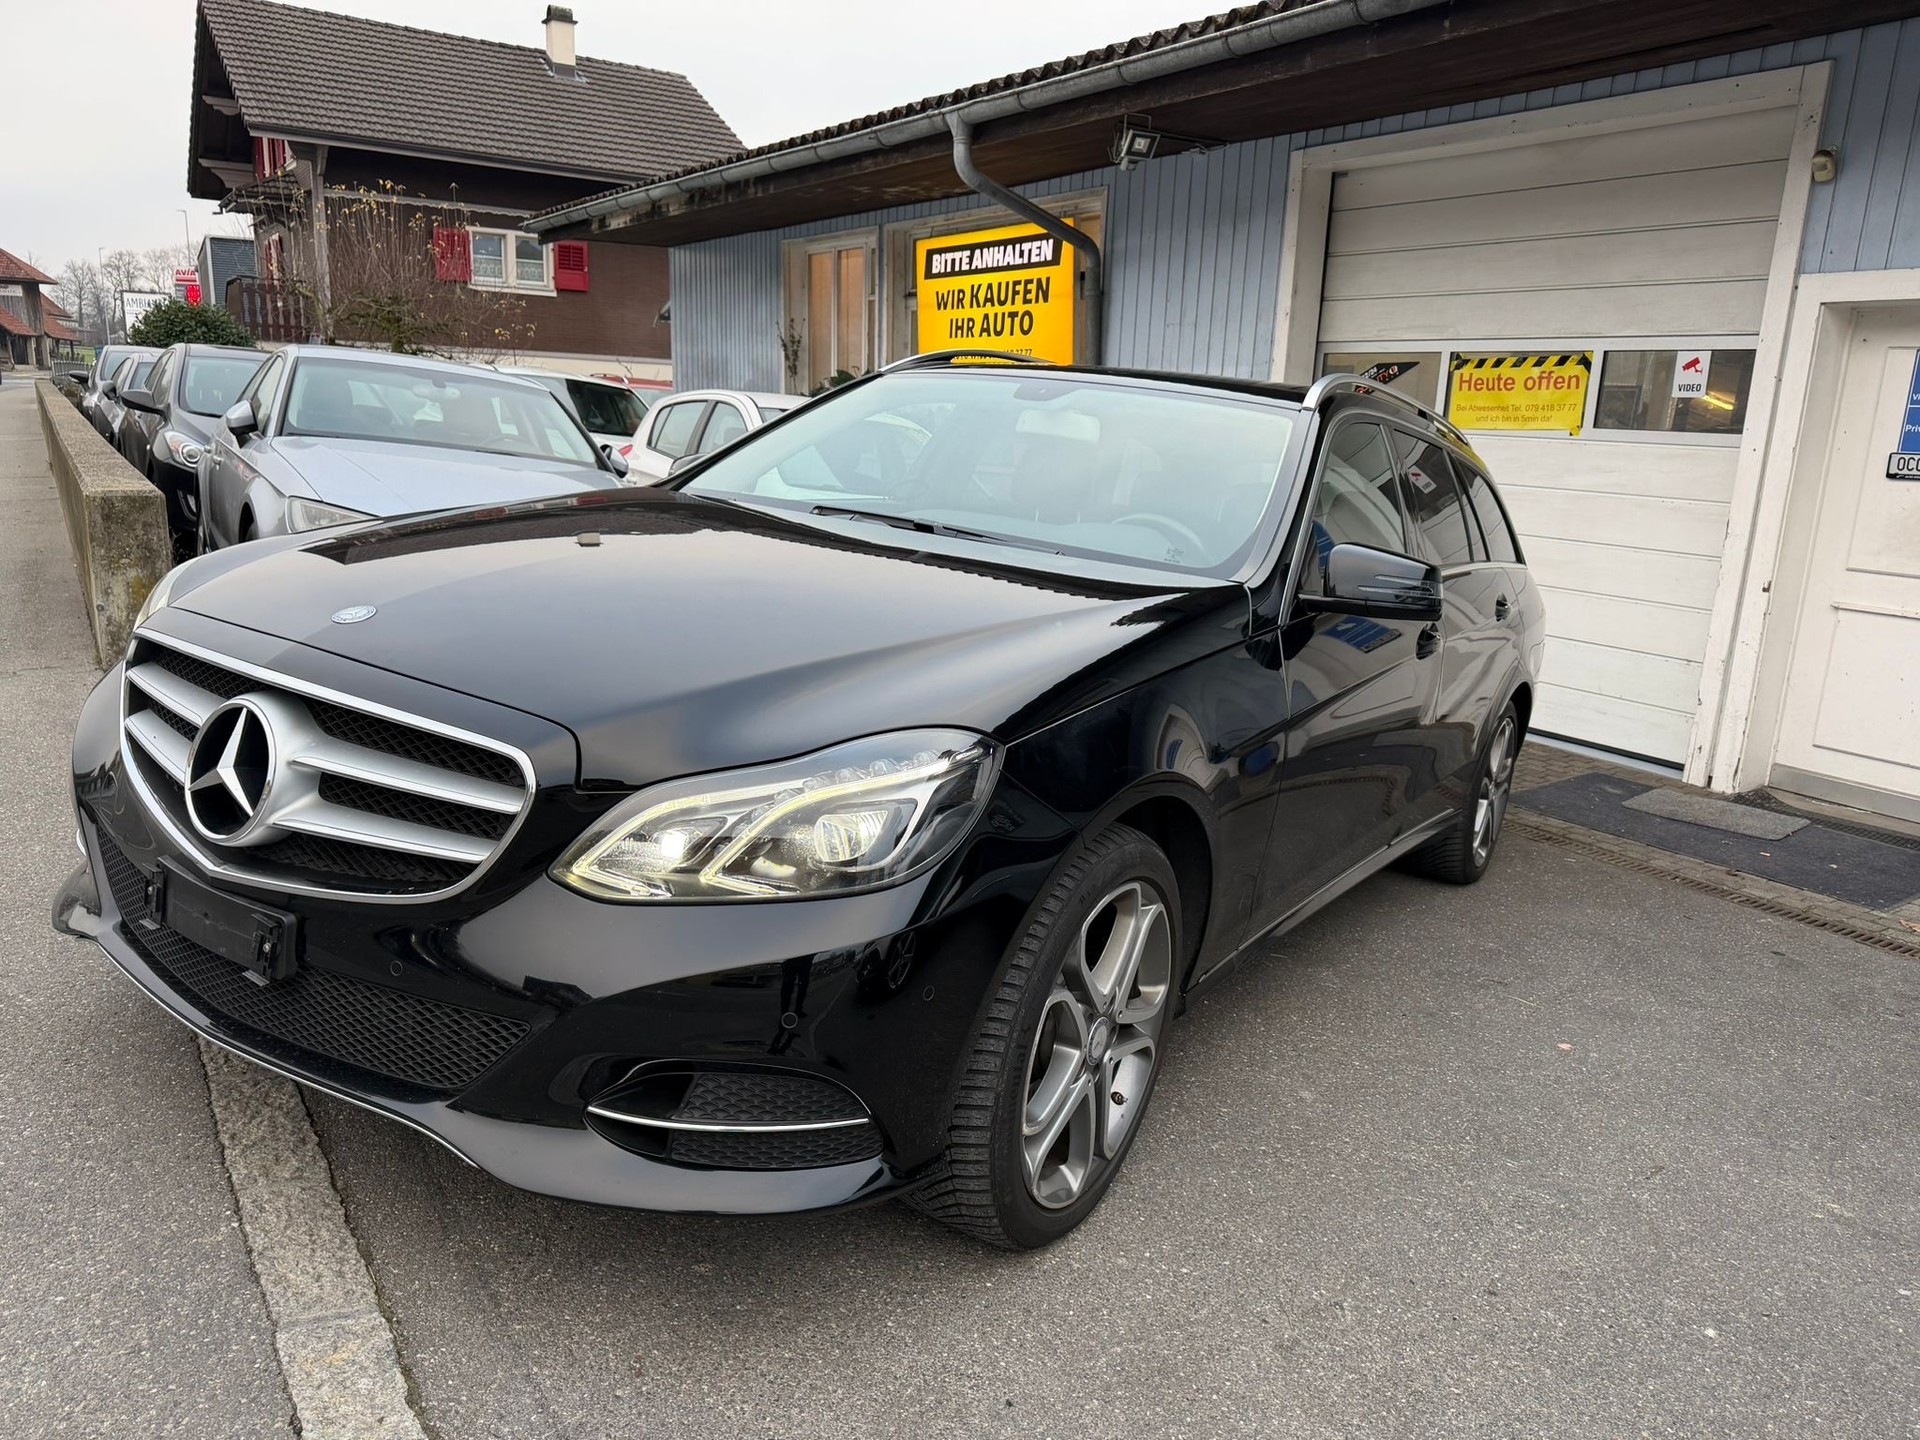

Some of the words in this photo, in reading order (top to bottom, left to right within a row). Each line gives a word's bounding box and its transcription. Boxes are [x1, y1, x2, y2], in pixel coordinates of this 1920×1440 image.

[932, 249, 971, 274] BITTE
[971, 238, 1054, 270] ANHALTEN
[935, 289, 966, 311] WIR
[969, 276, 1051, 309] KAUFEN
[949, 317, 976, 339] IHR
[979, 310, 1034, 338] AUTO
[1458, 372, 1516, 392] Heute
[1523, 370, 1580, 391] offen
[1678, 383, 1702, 392] VIDEO
[1456, 404, 1468, 412] Bei
[1468, 404, 1510, 412] Abwesenheit
[1511, 404, 1523, 412] Tel.
[1525, 404, 1540, 412] 079
[1540, 404, 1555, 412] 418
[1556, 403, 1566, 411] 37
[1568, 403, 1577, 411] 77
[1476, 415, 1489, 423] und
[1490, 415, 1500, 423] ich
[1501, 415, 1512, 423] bin
[1513, 415, 1520, 423] in
